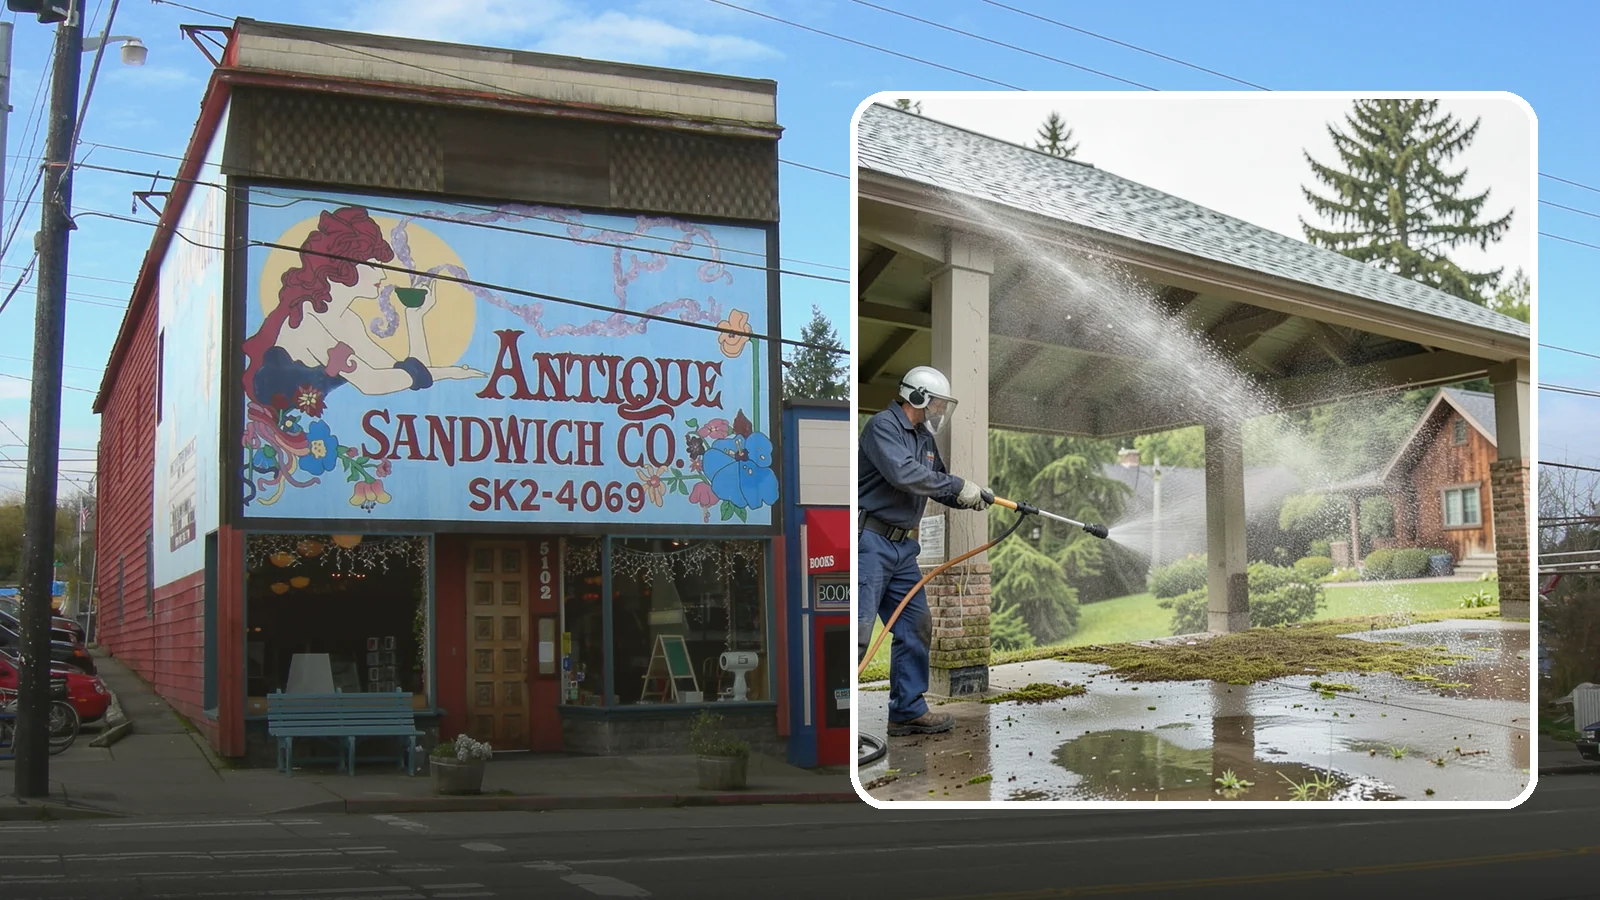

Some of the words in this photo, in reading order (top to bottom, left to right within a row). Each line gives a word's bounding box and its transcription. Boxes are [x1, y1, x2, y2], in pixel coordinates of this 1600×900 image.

[475, 329, 723, 421] ANTIQUE
[361, 408, 604, 467] SANDWICH
[617, 422, 685, 468] CO.
[468, 477, 646, 513] SK2-4069
[539, 541, 552, 600] 5102
[809, 555, 835, 569] BOOKS
